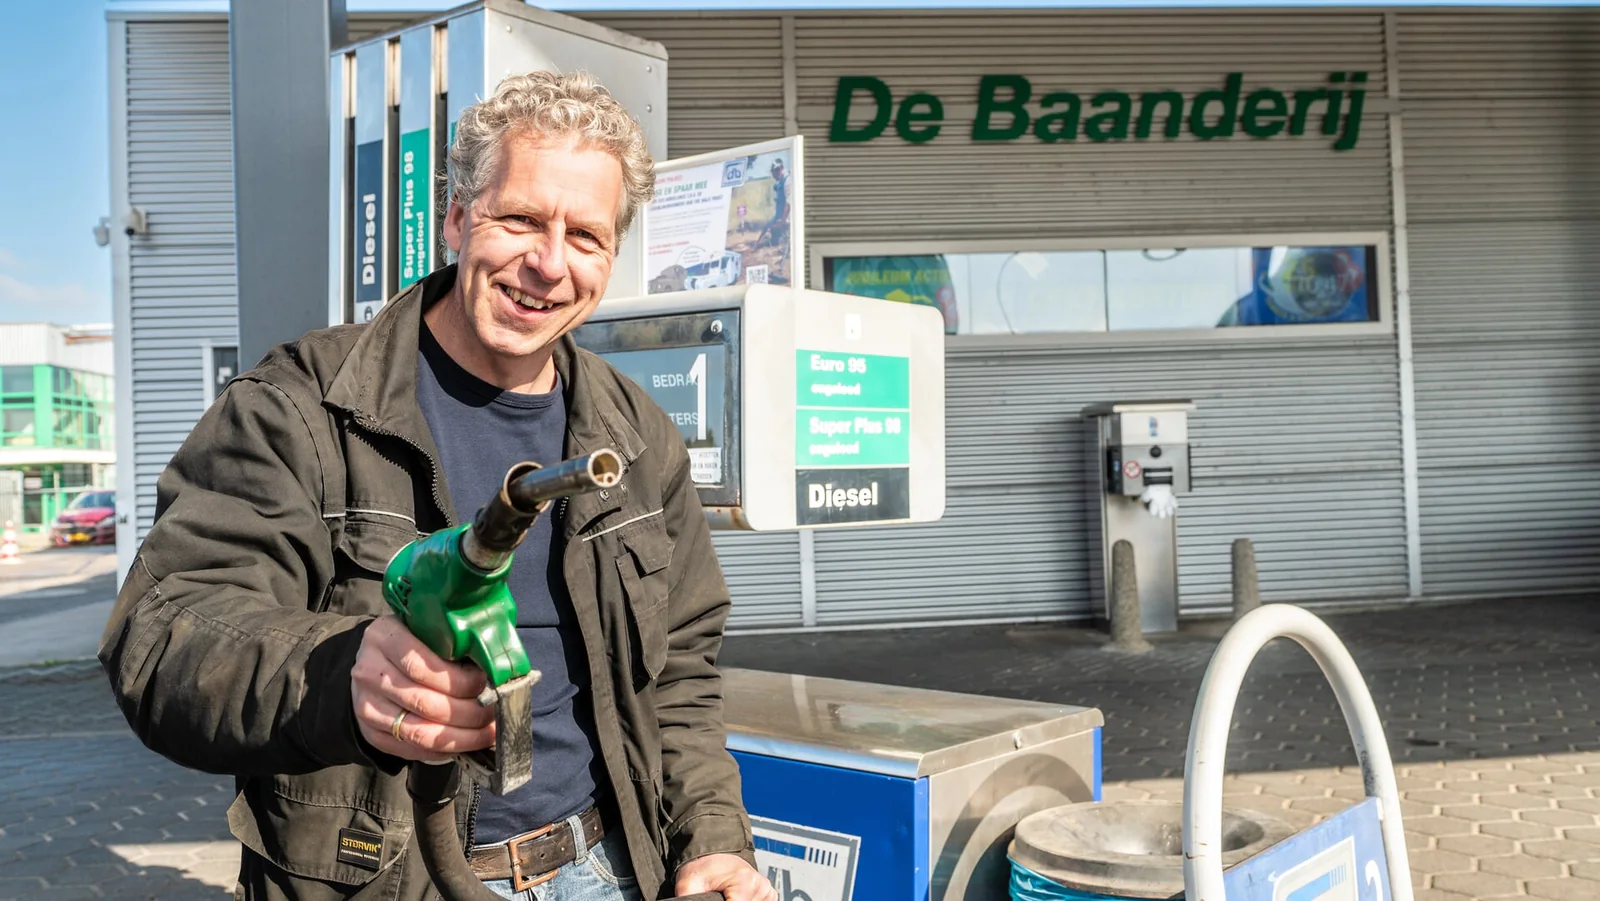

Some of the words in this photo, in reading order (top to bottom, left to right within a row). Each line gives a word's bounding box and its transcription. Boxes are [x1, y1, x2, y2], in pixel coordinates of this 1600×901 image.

[828, 74, 945, 145] De
[970, 71, 1369, 151] Baanderij
[403, 178, 414, 220] Plus
[362, 193, 376, 285] Diesel
[403, 223, 415, 279] Super
[416, 211, 426, 277] ongelood
[652, 373, 699, 388] BEDRA
[810, 354, 845, 372] Euro
[847, 357, 867, 374] 95
[689, 353, 707, 440] 1
[809, 416, 852, 438] Super
[854, 417, 883, 434] Plus
[809, 481, 878, 508] Diesel
